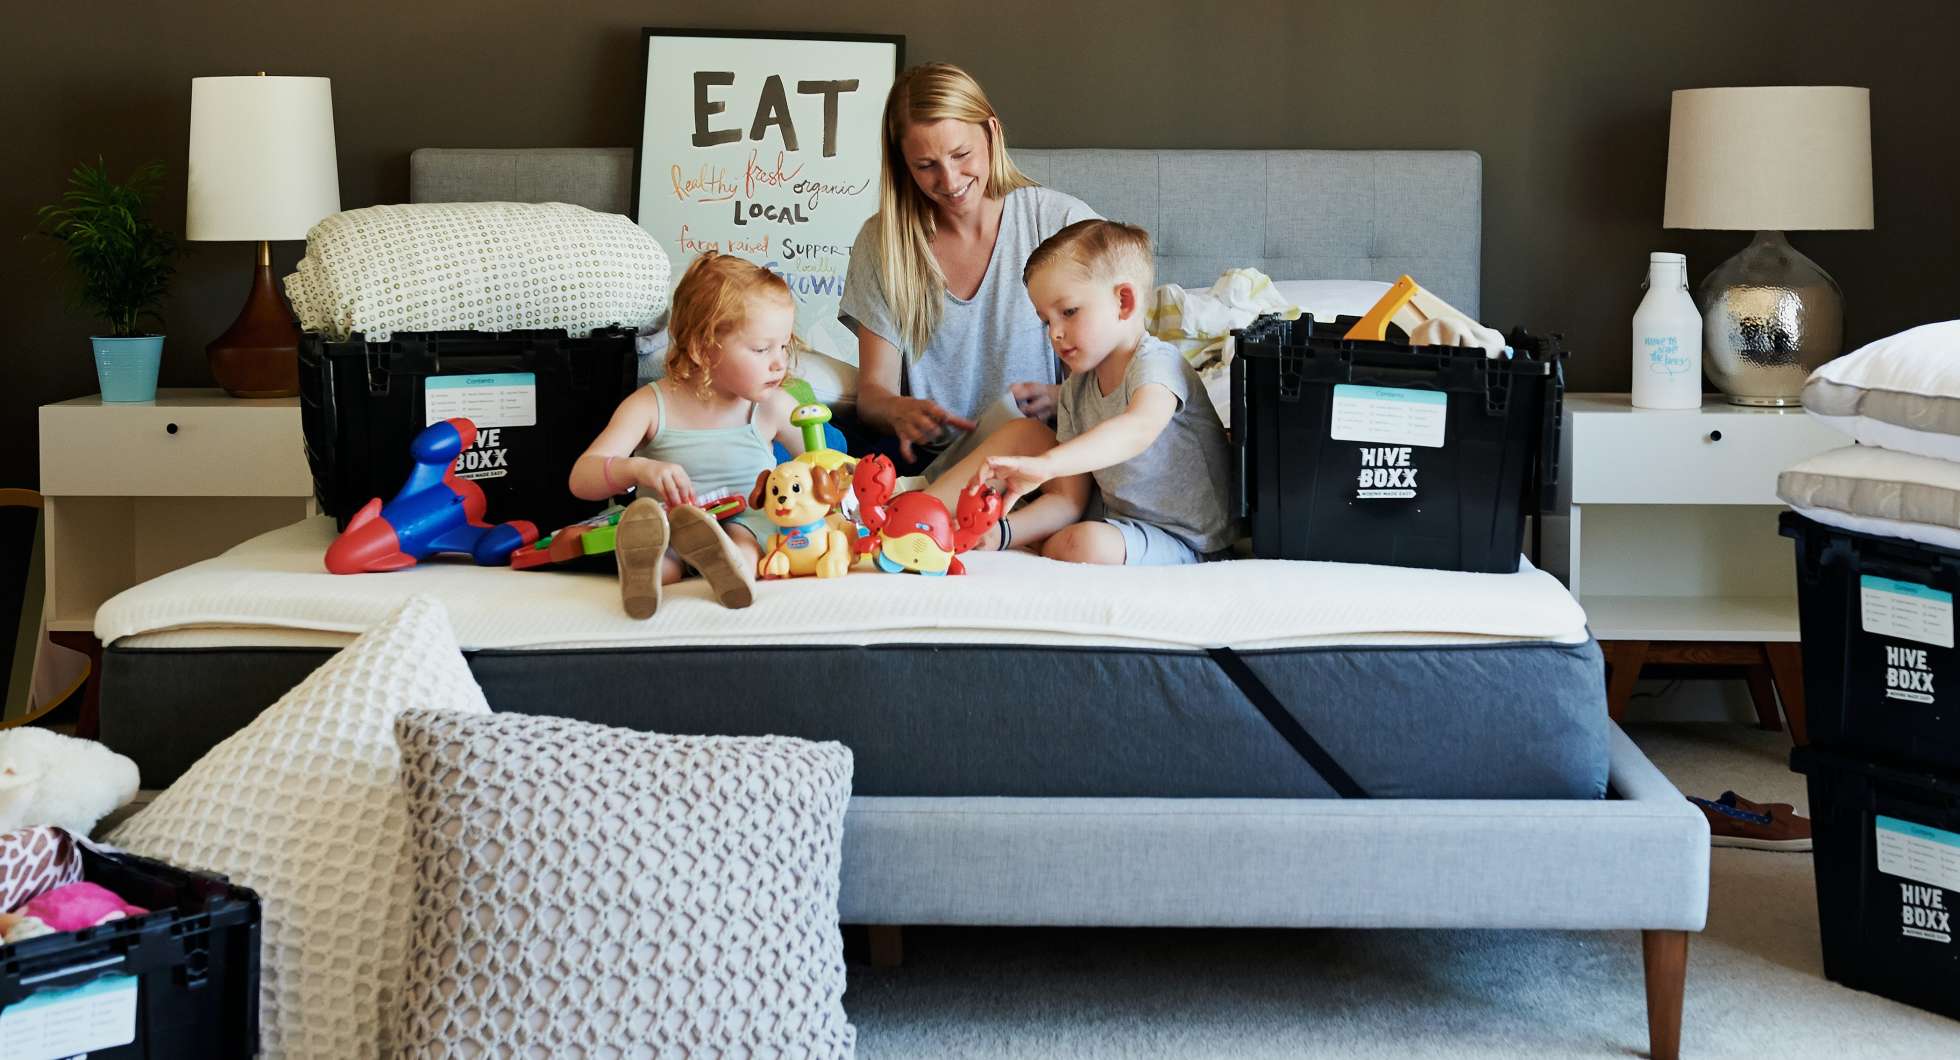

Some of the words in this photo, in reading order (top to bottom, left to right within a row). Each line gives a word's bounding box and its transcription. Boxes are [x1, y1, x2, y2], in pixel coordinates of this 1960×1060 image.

[692, 71, 859, 157] EAT
[745, 150, 804, 199] fresh
[793, 179, 869, 210] organic
[734, 200, 809, 226] LOCAL
[675, 224, 720, 253] farm
[1360, 447, 1412, 467] HIVE
[1357, 468, 1418, 488] BOXX
[1885, 646, 1927, 670] HIVE
[1885, 668, 1935, 693] BOXX
[1900, 884, 1943, 909] HIVE
[1902, 905, 1951, 933] BOXX
